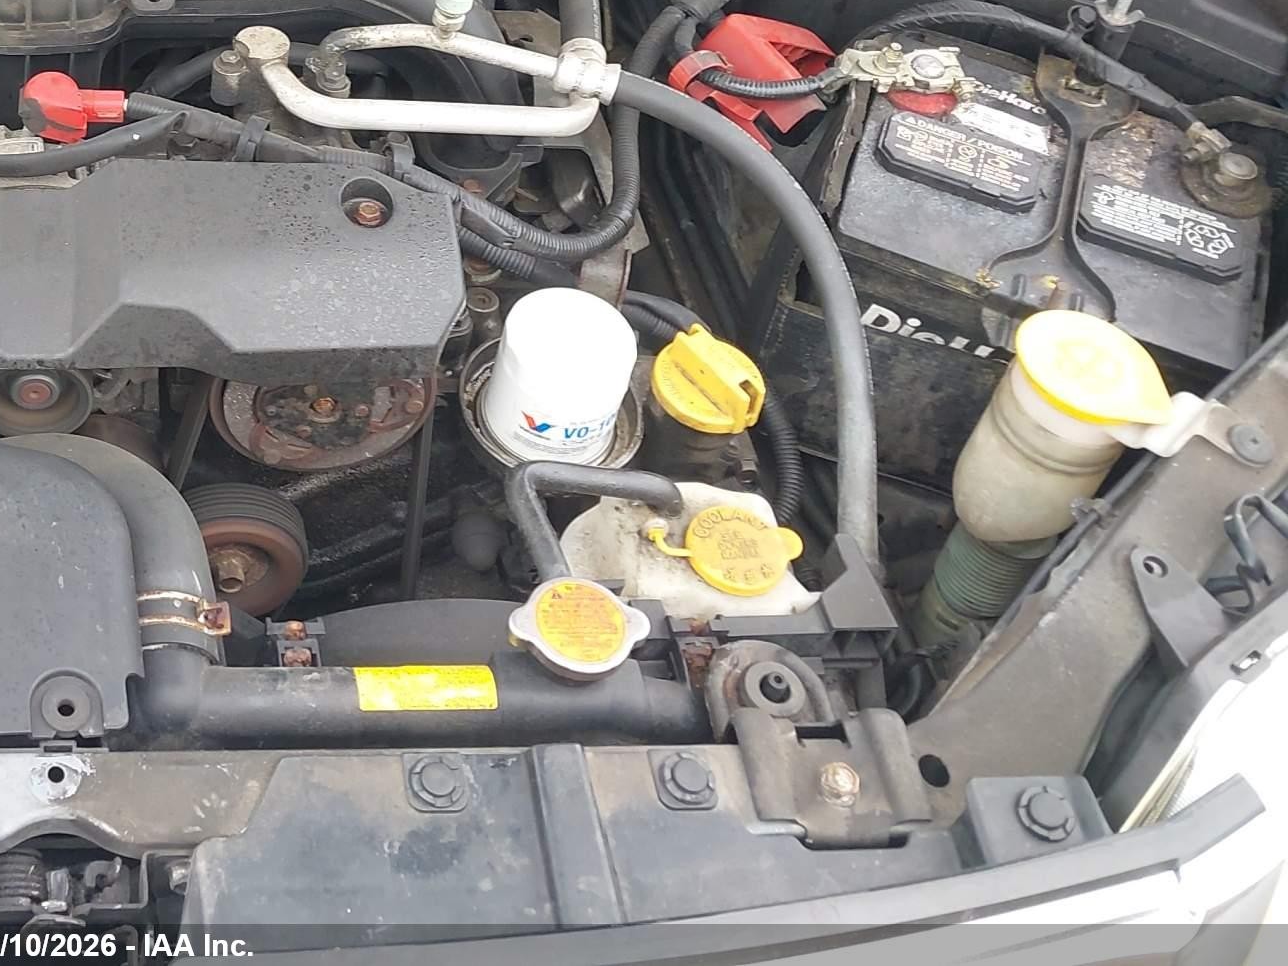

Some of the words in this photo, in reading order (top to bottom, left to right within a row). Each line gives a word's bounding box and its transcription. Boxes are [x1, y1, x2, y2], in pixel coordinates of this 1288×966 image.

[917, 117, 967, 142] DANGER
[977, 139, 1024, 160] POISON
[693, 509, 769, 539] COOLANT
